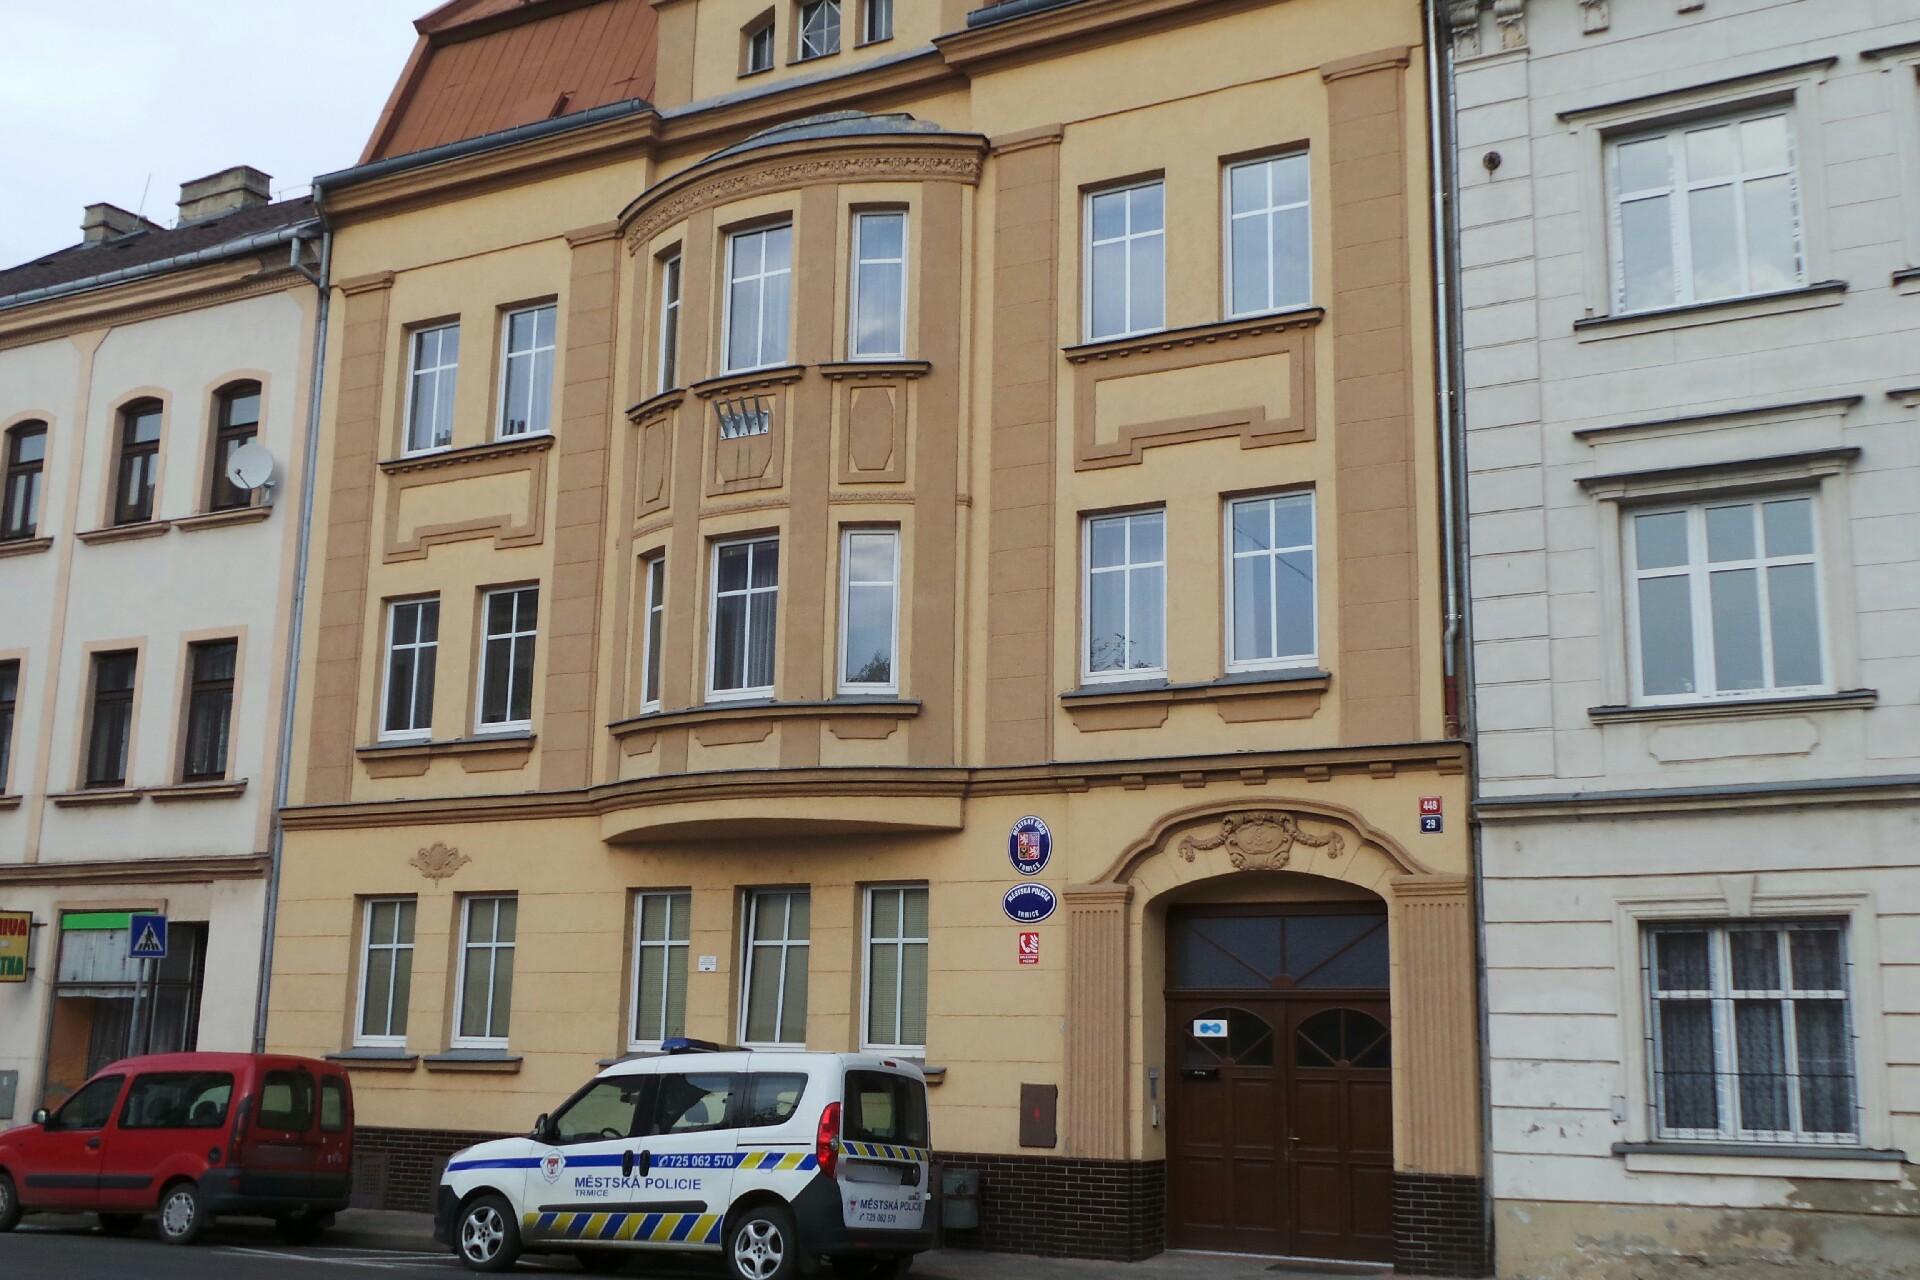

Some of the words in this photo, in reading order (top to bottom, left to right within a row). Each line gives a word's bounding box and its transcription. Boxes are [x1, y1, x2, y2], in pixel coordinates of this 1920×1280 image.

[1426, 819, 1436, 829] 29
[1018, 861, 1041, 872] TRMICE
[1007, 886, 1031, 903] MĚSTSKÁ
[1031, 887, 1051, 902] POLICIE
[1017, 909, 1040, 919] TRMICE
[670, 1155, 689, 1167] 725
[691, 1155, 711, 1167] 062
[714, 1154, 734, 1167] 570
[574, 1174, 641, 1189] MĚSTSKÁ
[645, 1177, 702, 1190] POLICIE
[575, 1189, 609, 1197] TRMICE
[860, 1198, 899, 1211] MĚSTSKÁ
[866, 1212, 876, 1223] 725
[877, 1213, 887, 1223] 062
[887, 1214, 897, 1224] 570
